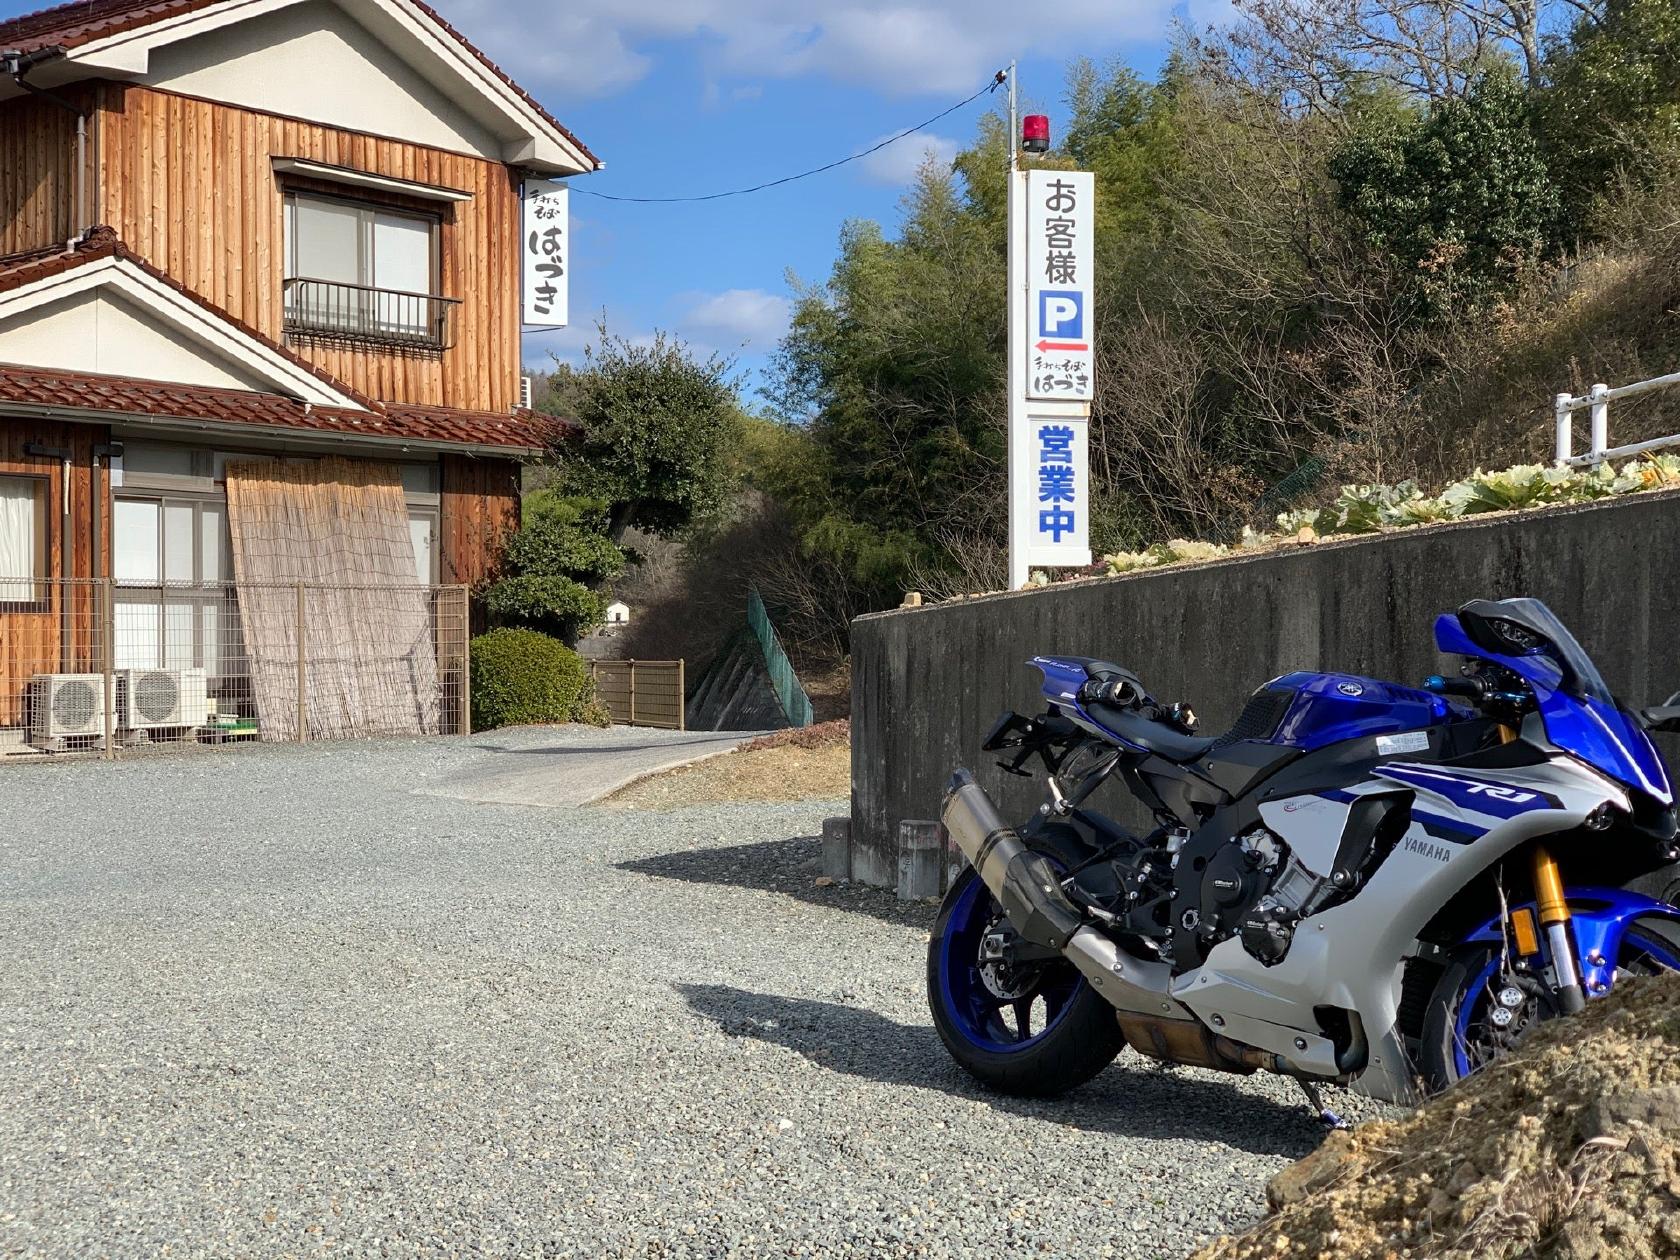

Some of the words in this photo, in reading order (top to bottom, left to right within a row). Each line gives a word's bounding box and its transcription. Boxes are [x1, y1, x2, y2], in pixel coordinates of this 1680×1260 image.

[534, 205, 560, 219] そば
[1045, 178, 1076, 285] お客様
[529, 225, 564, 315] はづき
[1045, 296, 1078, 332] P
[1034, 373, 1089, 395] はづき
[1038, 425, 1075, 543] 営業中
[1404, 837, 1451, 862] YAMAHA
